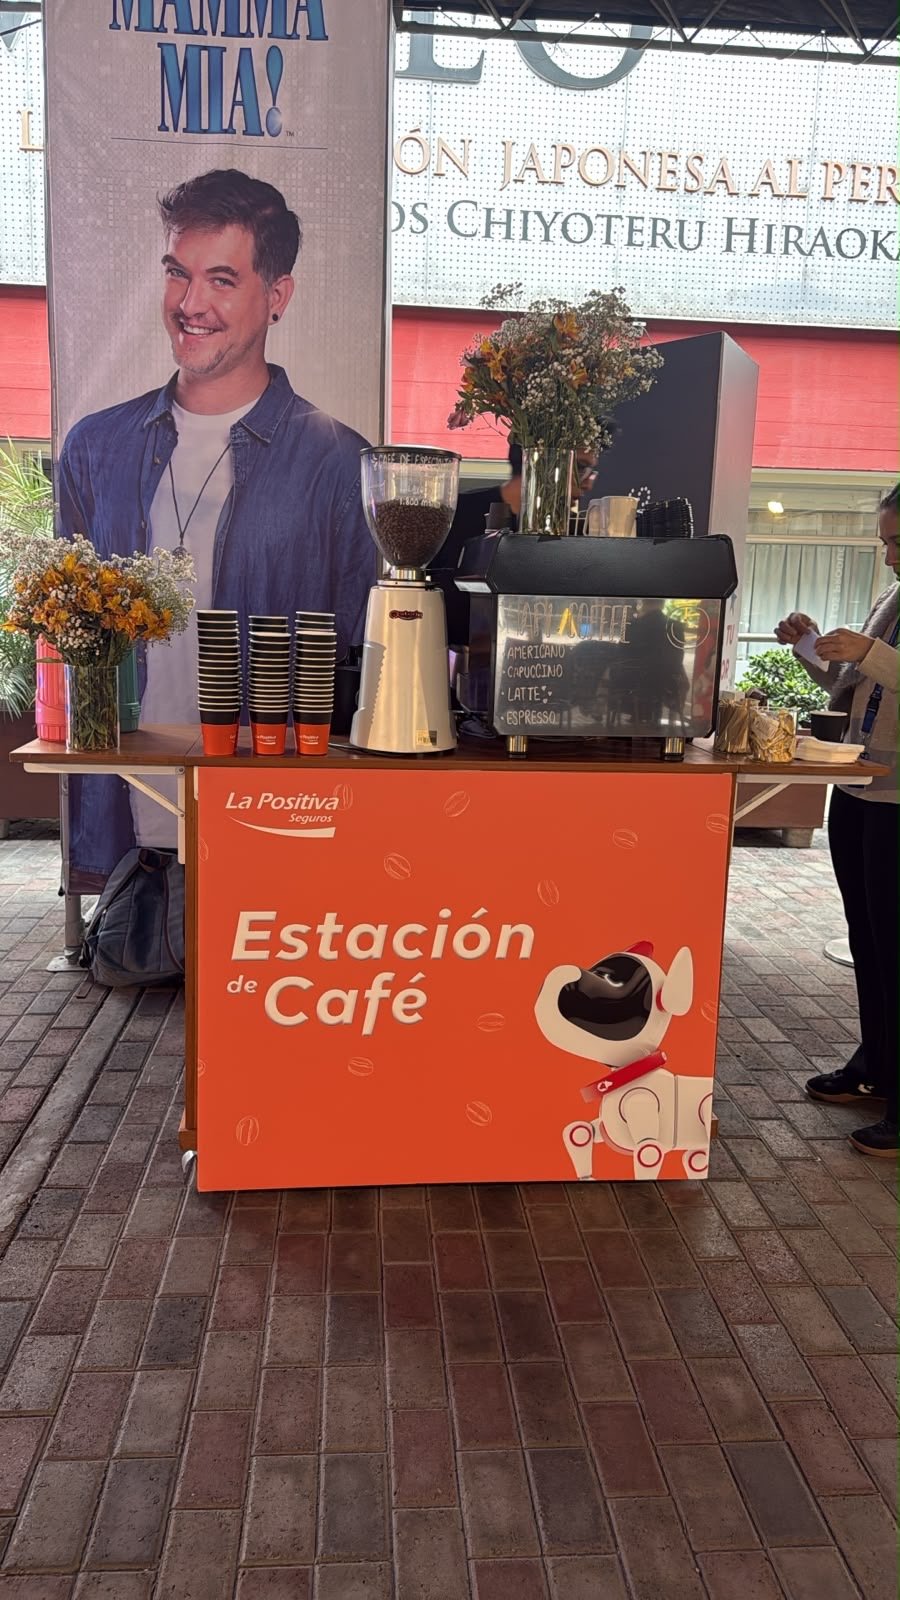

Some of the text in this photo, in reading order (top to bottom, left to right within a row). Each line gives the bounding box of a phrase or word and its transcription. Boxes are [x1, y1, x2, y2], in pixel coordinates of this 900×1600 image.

[157, 42, 284, 138] MIA!
[393, 128, 472, 177] ÓN
[500, 140, 740, 196] JAPONESA
[751, 158, 808, 199] AL
[446, 199, 706, 252] CHIYOTERU
[722, 217, 900, 262] HIRAOK
[507, 643, 566, 660] AMERICANO
[507, 663, 563, 679] CAPUCCINO
[507, 686, 541, 702] LATTE
[506, 709, 556, 726] ESPRESSO
[225, 792, 340, 811] La Positiva
[288, 813, 333, 825] Seguros
[231, 907, 535, 961] Estación
[226, 971, 428, 1036] de Café
